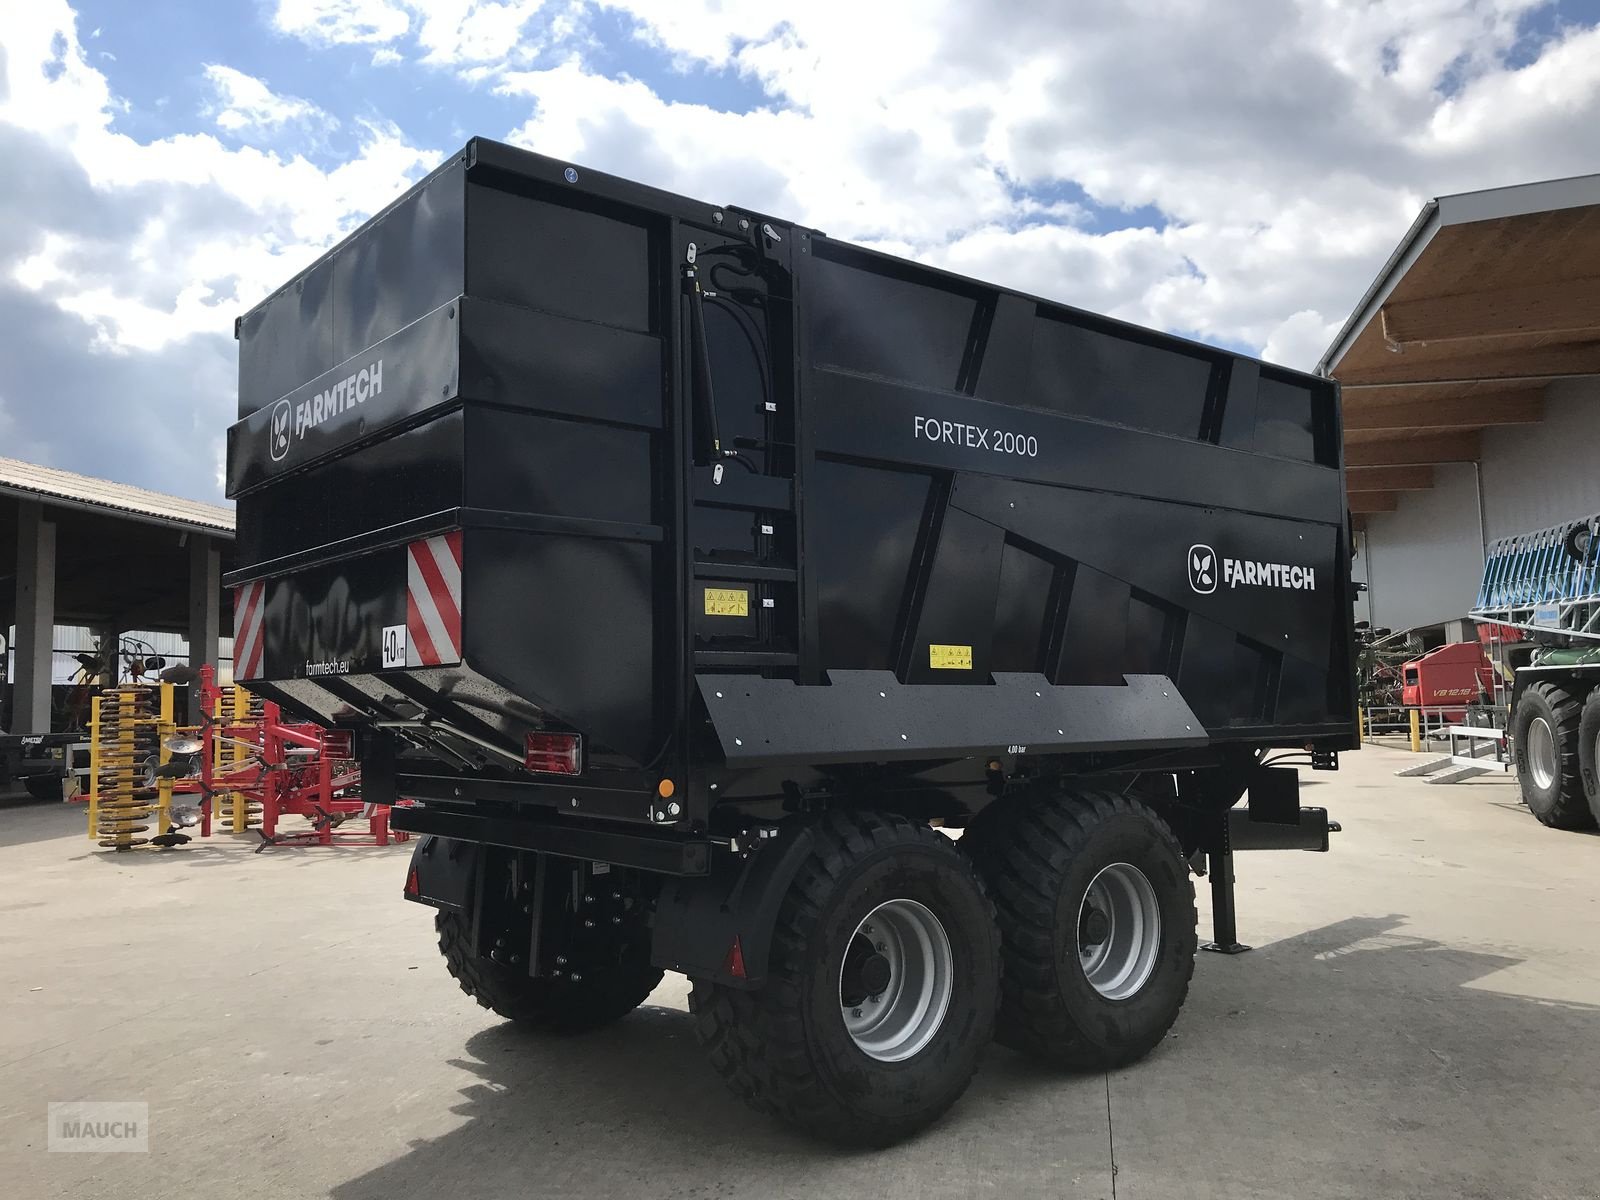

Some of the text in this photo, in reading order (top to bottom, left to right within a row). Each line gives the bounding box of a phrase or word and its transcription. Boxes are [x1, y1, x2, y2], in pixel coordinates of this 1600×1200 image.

[295, 359, 383, 440] FARMTECH
[914, 415, 1038, 457] FORTEX 2000
[1223, 558, 1316, 591] FARMTECH
[384, 630, 404, 663] 40 km
[306, 657, 350, 676] farmtech.eu
